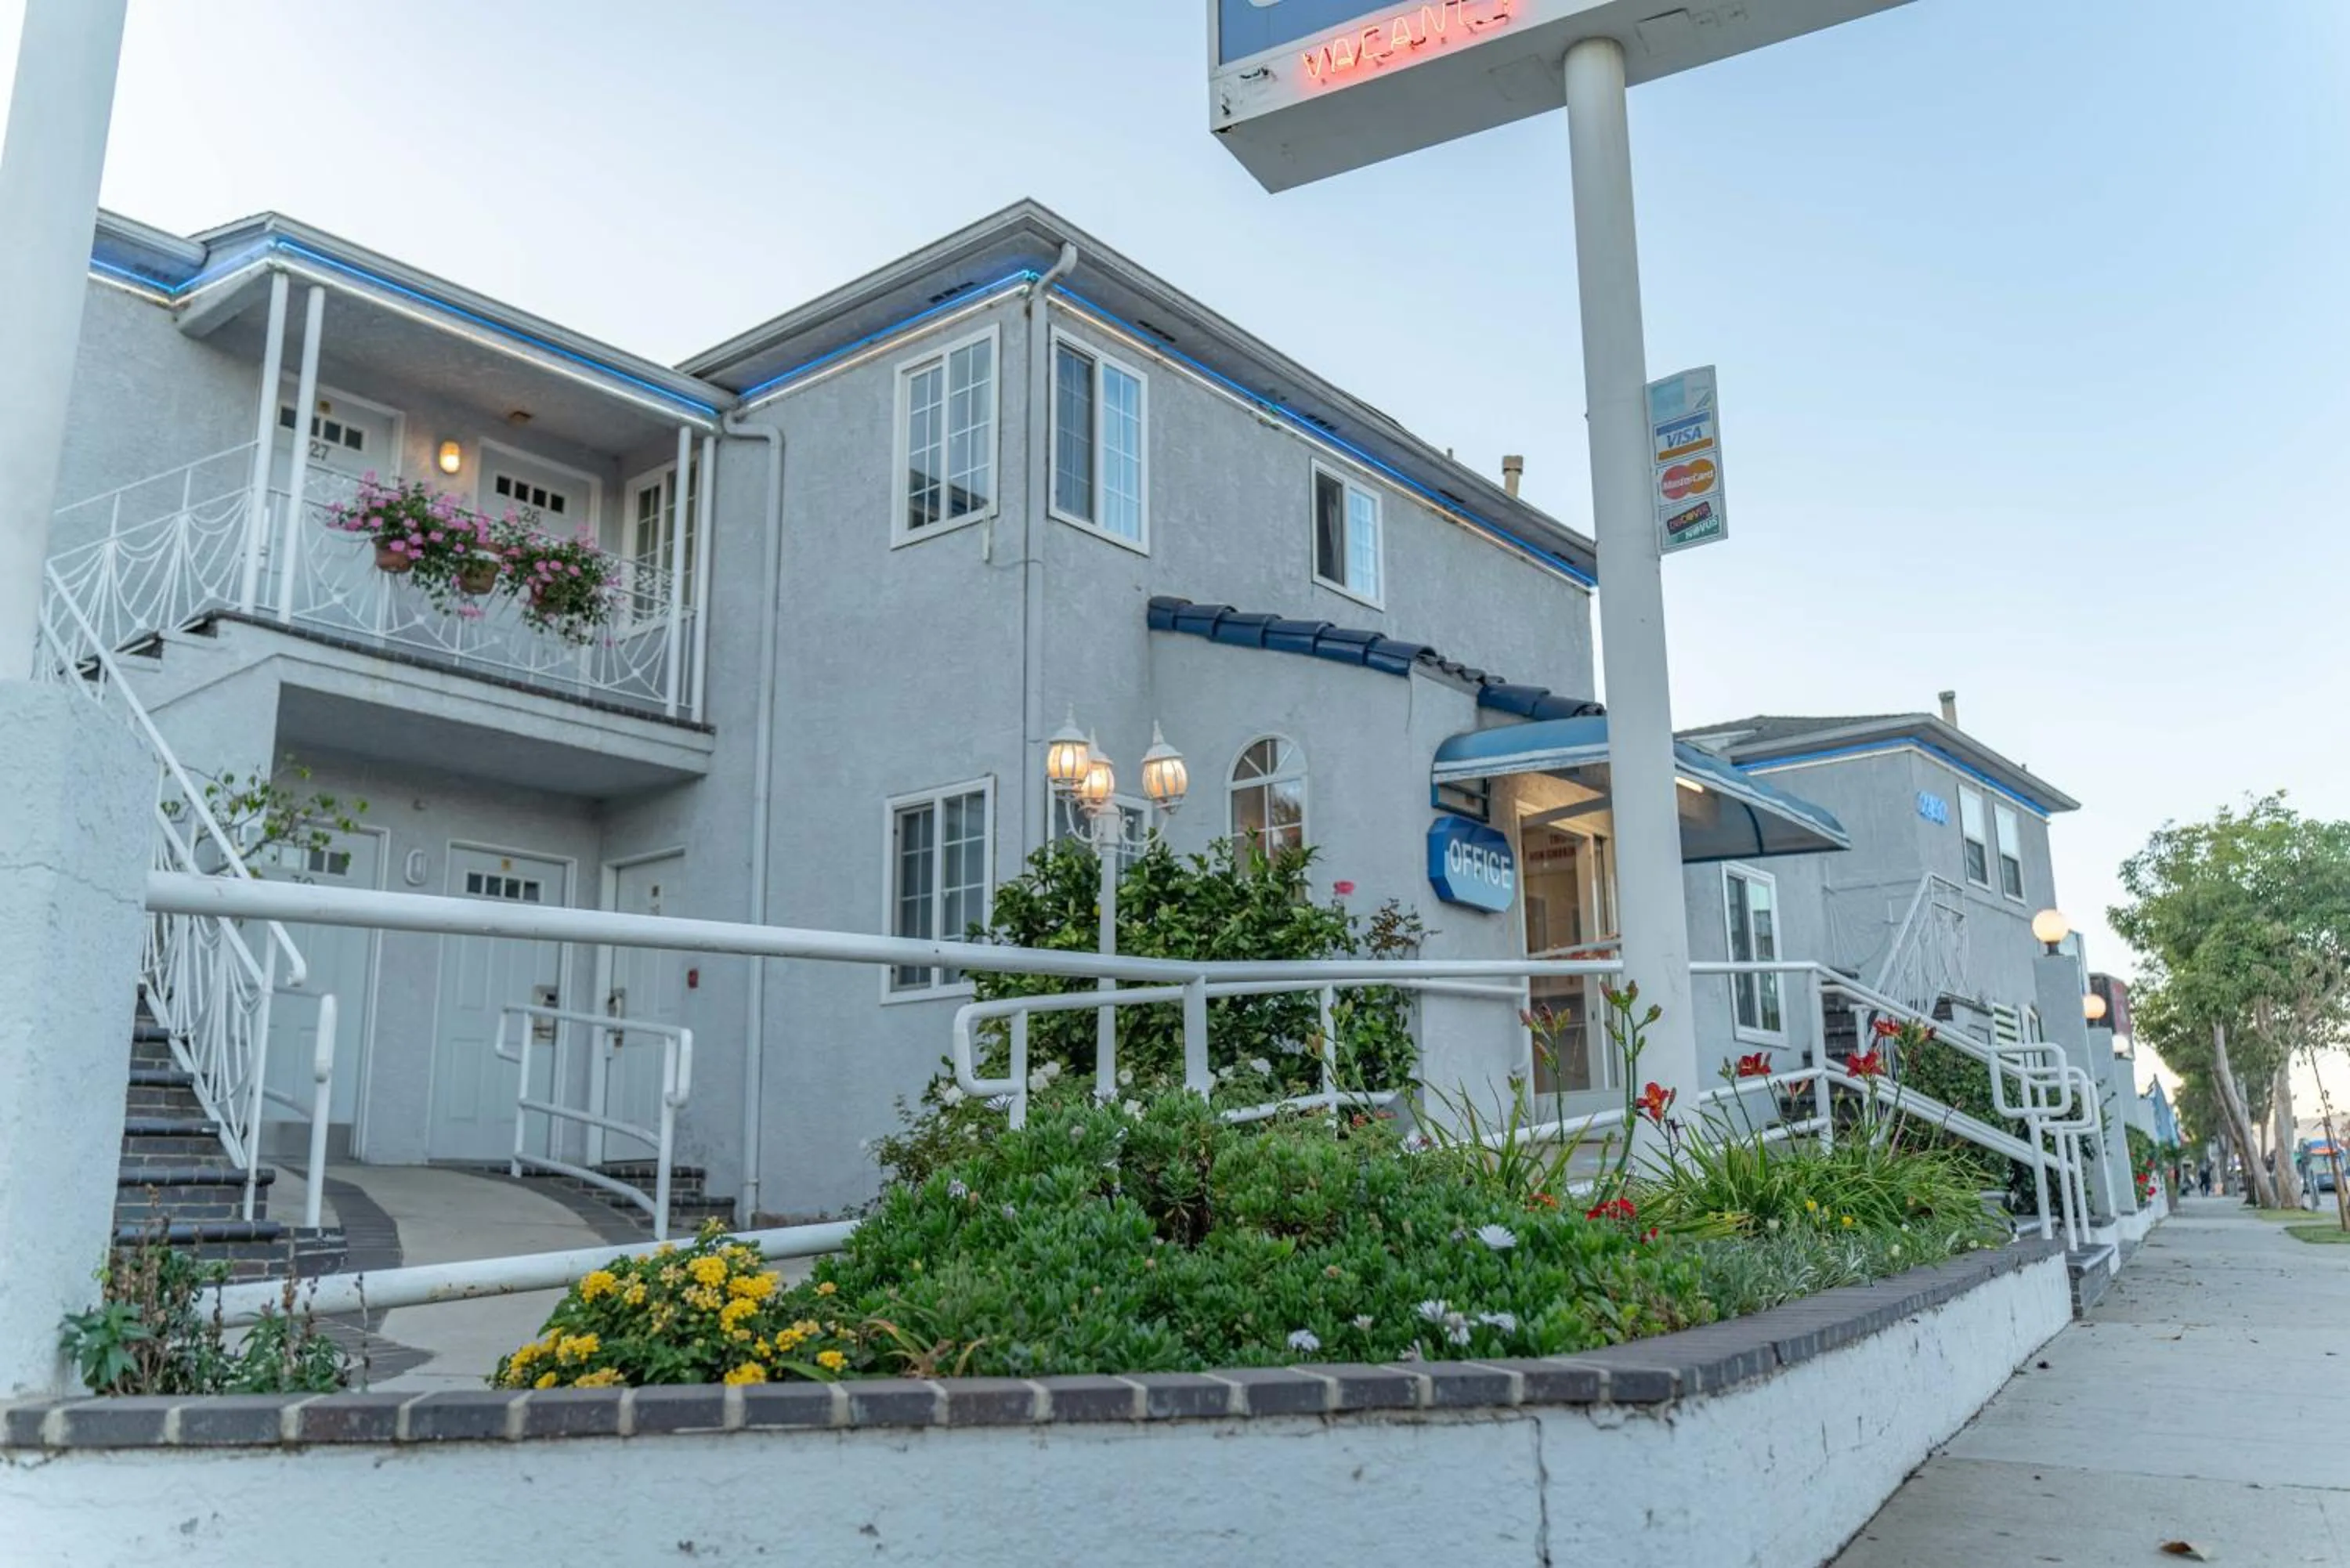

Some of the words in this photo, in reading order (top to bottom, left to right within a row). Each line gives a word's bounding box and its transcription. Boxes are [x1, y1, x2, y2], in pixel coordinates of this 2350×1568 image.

[1667, 426, 1702, 448] VISA
[309, 441, 331, 461] 27
[521, 507, 540, 526] 26
[1449, 838, 1511, 890] OFFICE
